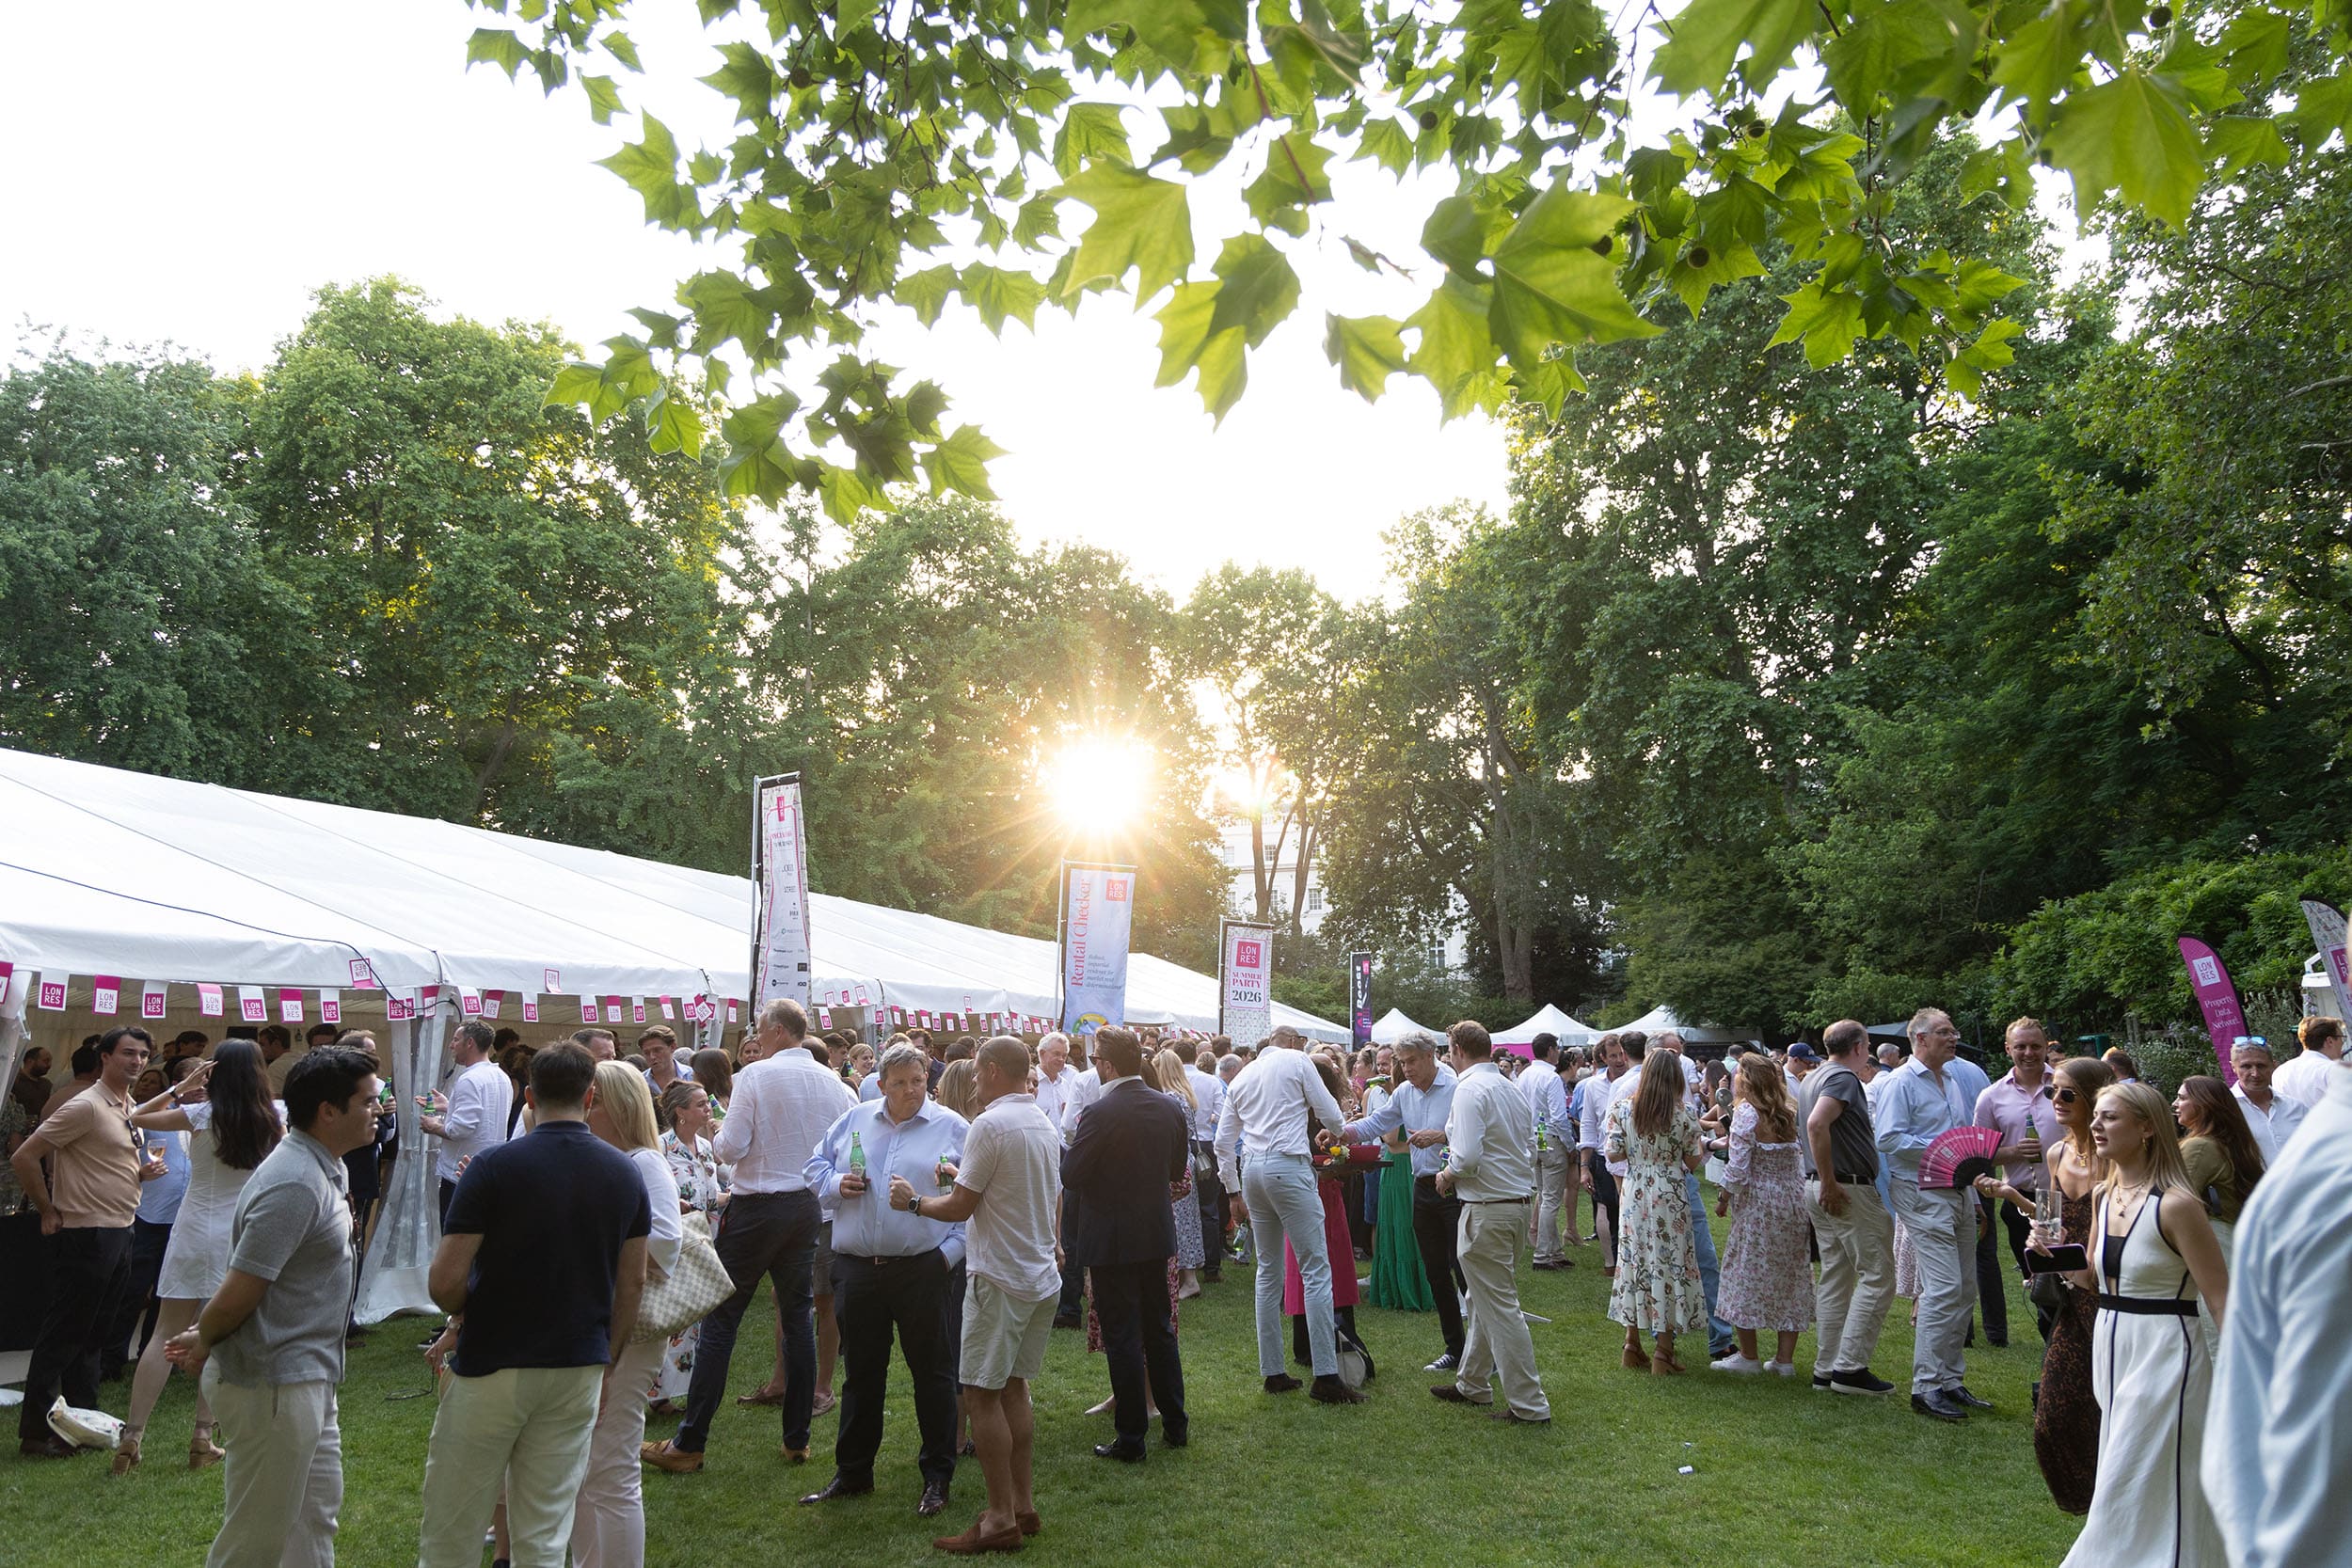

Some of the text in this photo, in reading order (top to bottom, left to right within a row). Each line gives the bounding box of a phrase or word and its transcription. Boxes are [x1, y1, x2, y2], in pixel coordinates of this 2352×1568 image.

[1071, 879, 1090, 986] Rental Checker
[1241, 945, 1257, 956] LON
[1240, 955, 1256, 964] RES
[2197, 961, 2214, 972] LON
[2201, 971, 2216, 981] RES
[1232, 978, 1261, 988] PARTY
[45, 987, 62, 996] LON
[1232, 990, 1262, 1003] 2026
[44, 995, 61, 1005] RES
[99, 992, 114, 1002] LON
[99, 1001, 114, 1009] RES
[206, 1004, 219, 1012] RES
